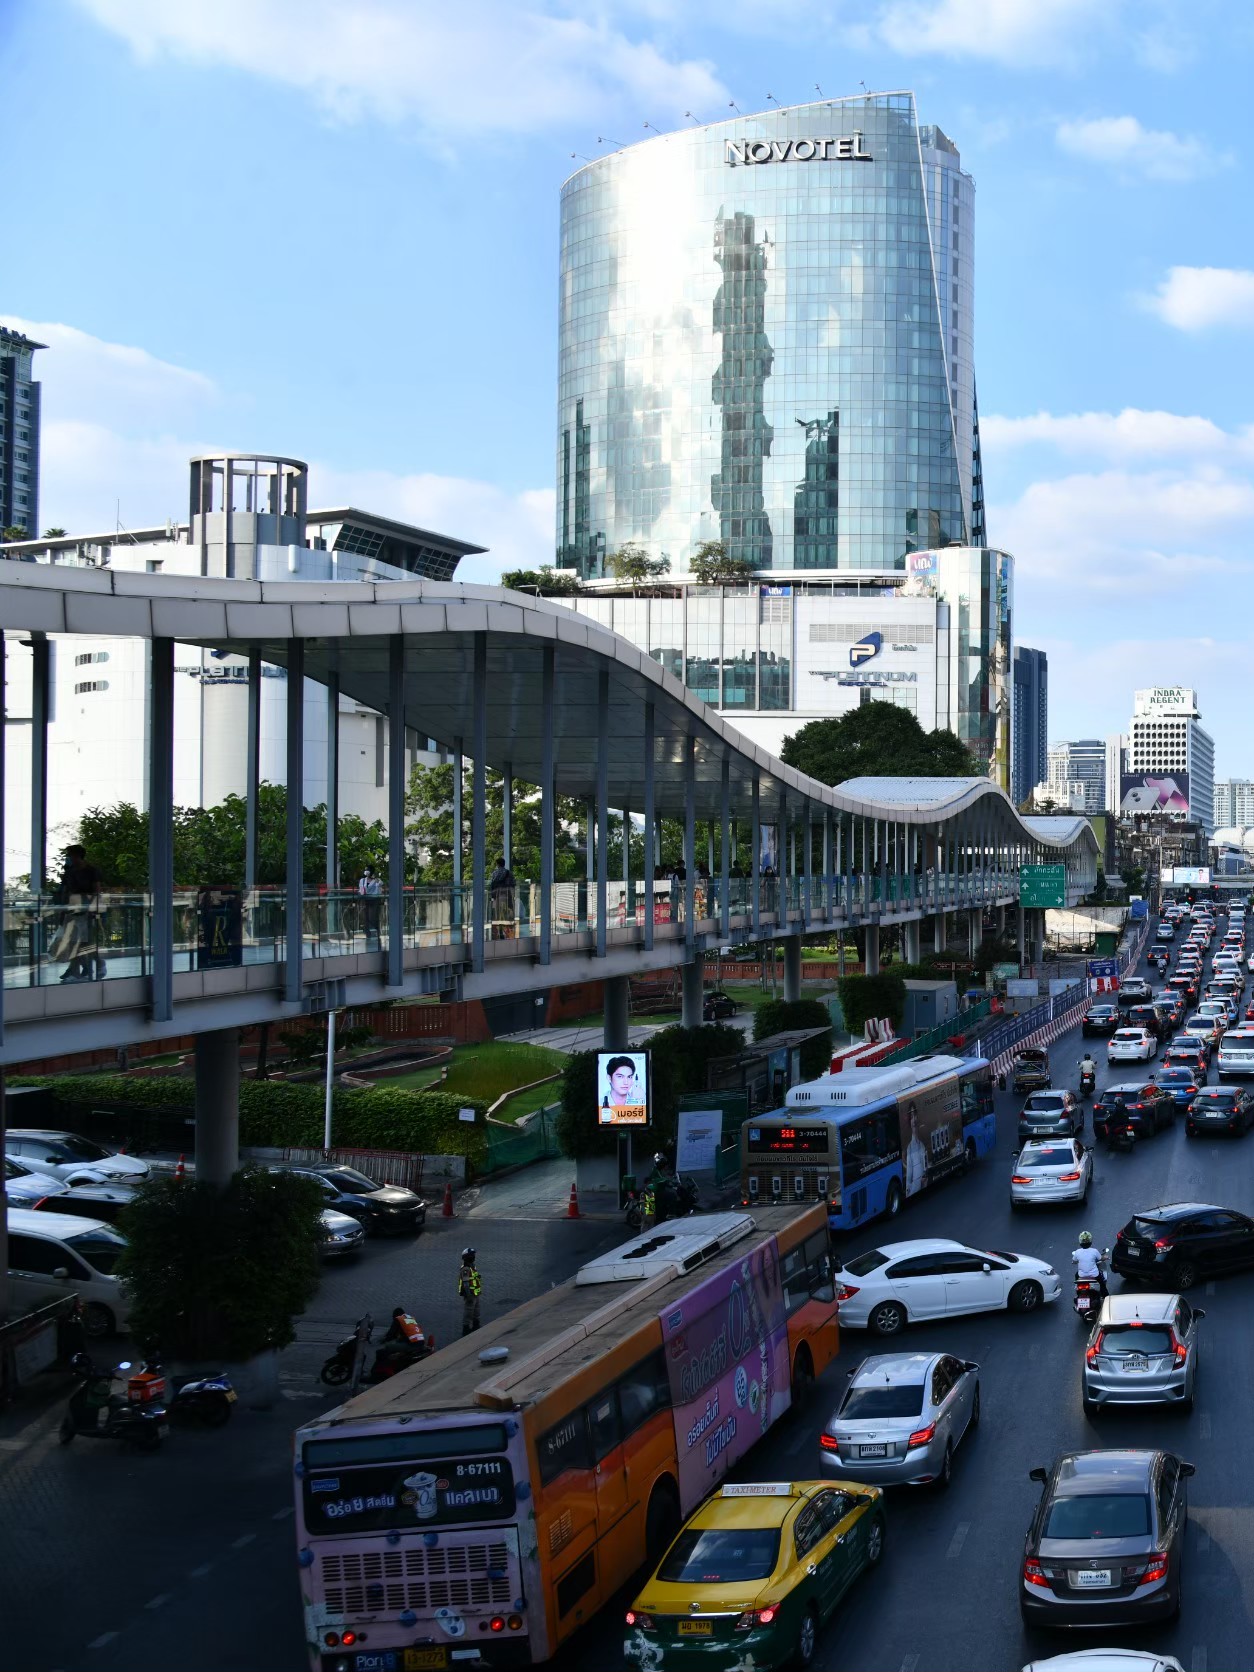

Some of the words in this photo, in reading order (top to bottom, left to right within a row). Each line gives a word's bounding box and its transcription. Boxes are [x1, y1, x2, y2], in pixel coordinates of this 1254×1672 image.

[725, 130, 872, 164] NOVOTEL
[823, 671, 918, 682] PLATINUM
[1153, 689, 1182, 697] INDRA
[456, 1462, 501, 1476] 8-67111
[446, 1487, 498, 1505] แคลเบา
[326, 1499, 364, 1518] อร่อย
